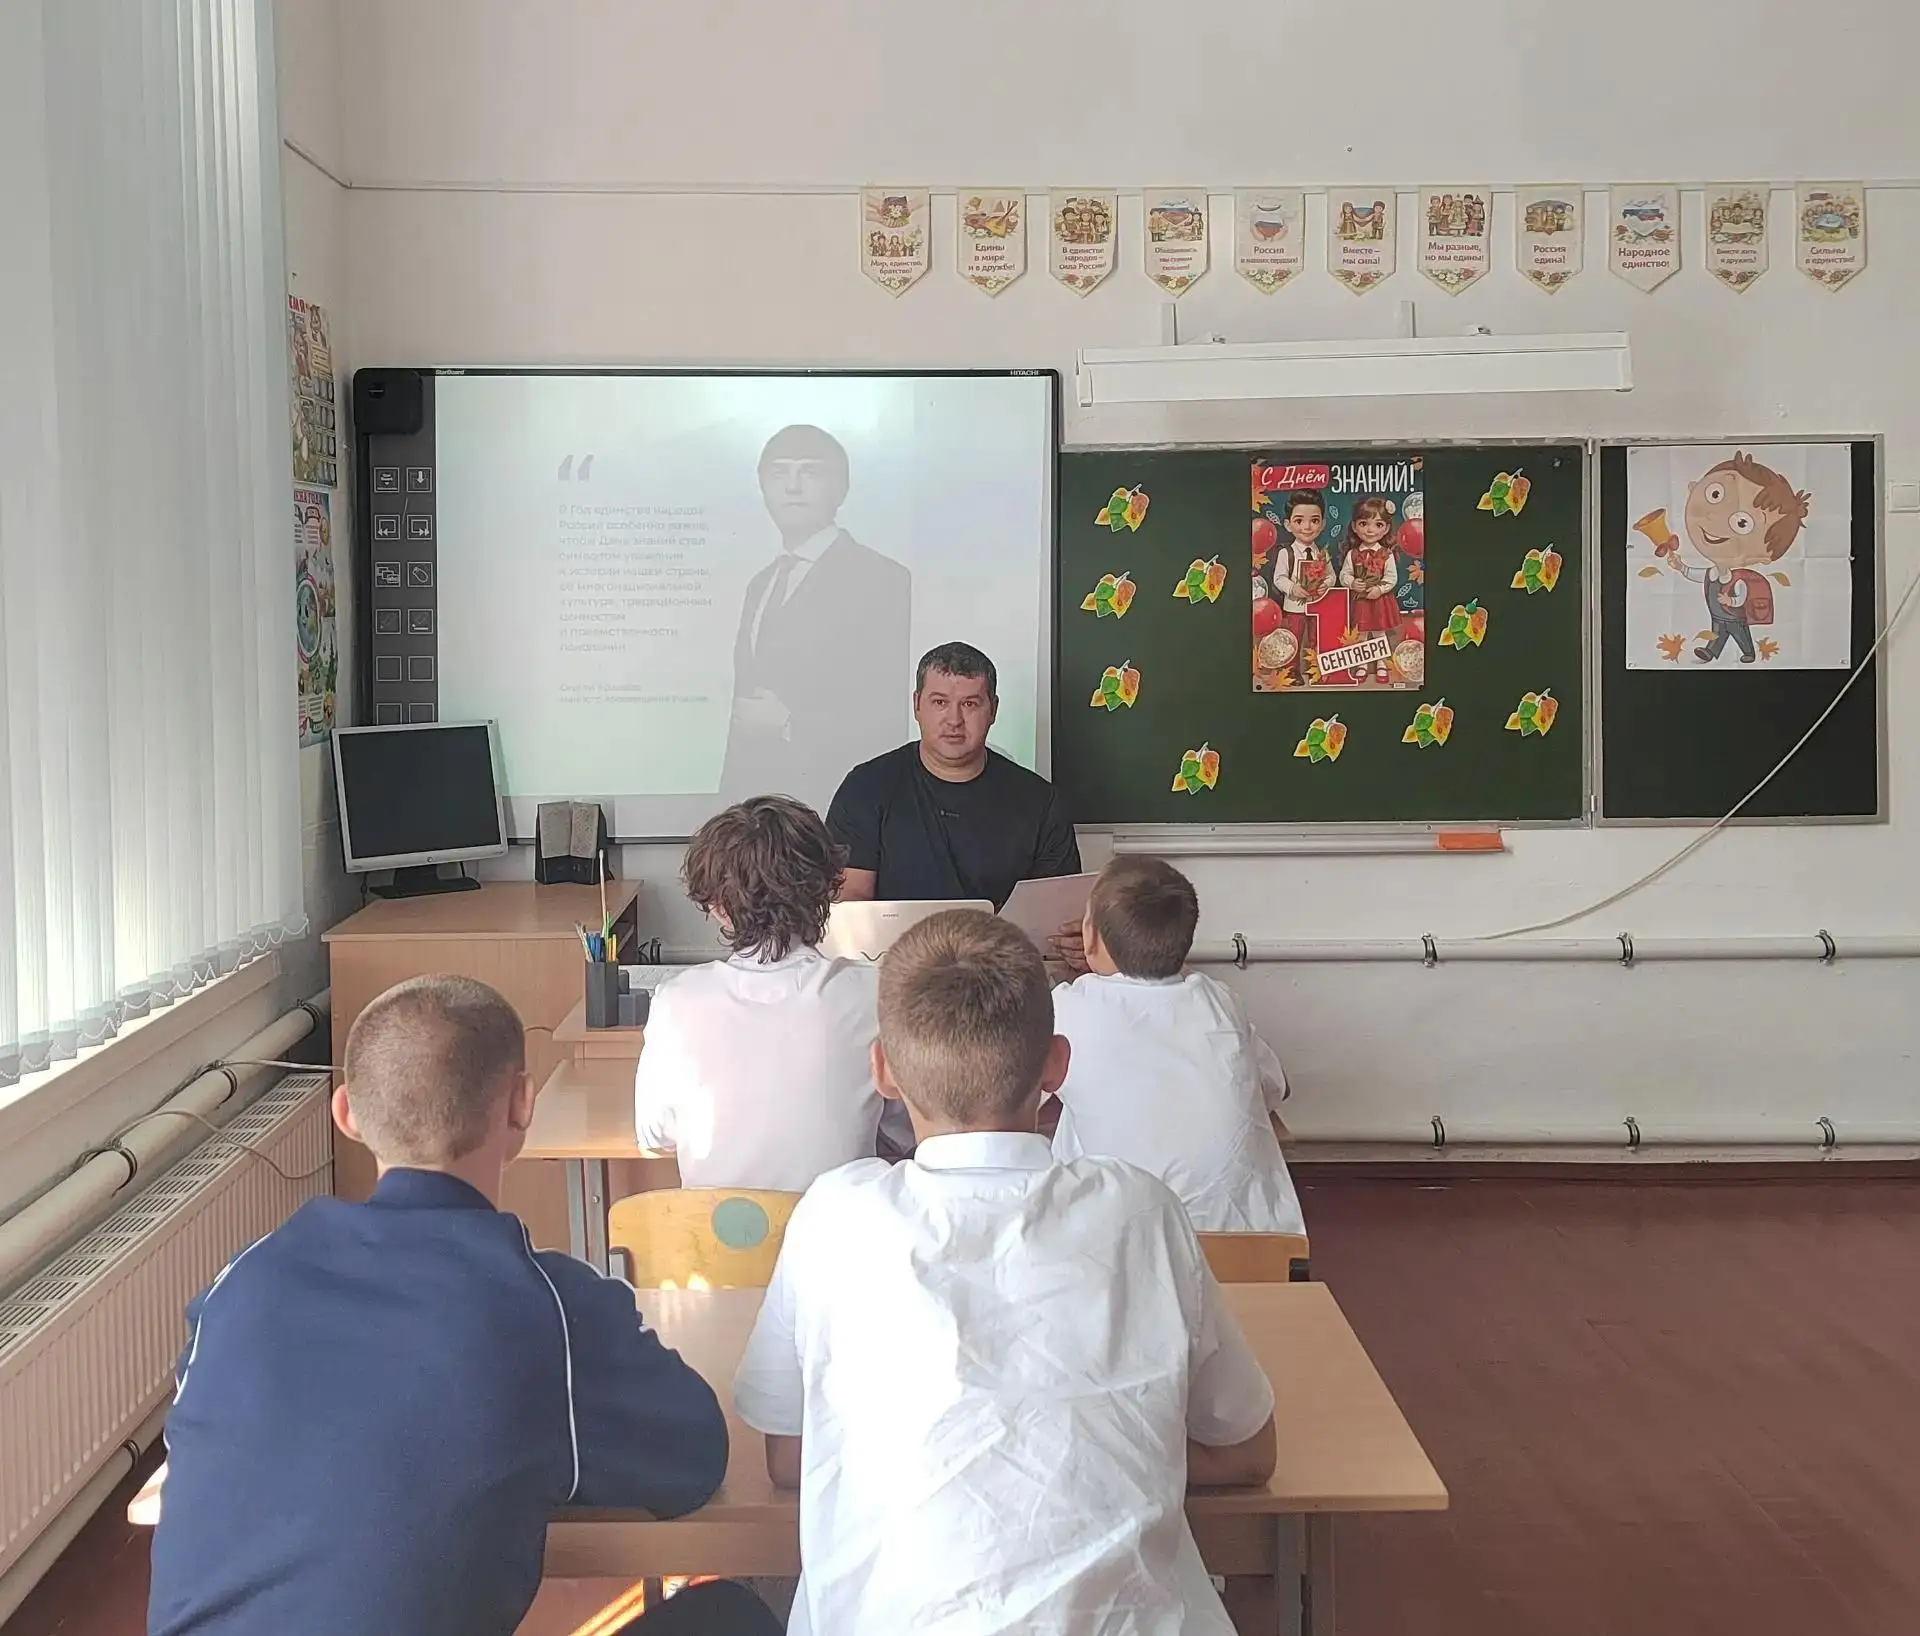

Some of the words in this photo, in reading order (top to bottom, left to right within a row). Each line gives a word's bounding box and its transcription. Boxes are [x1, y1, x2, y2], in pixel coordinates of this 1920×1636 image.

[975, 244, 1005, 253] Едины
[1428, 242, 1443, 251] Мы
[1446, 244, 1481, 252] разные,
[1534, 245, 1566, 253] Россия
[1811, 246, 1846, 255] Сильны
[1618, 248, 1670, 257] Народное
[982, 255, 1004, 263] мире
[1535, 255, 1565, 264] едина!
[982, 263, 1015, 272] дружбе!
[1622, 261, 1669, 269] единство!
[1261, 466, 1273, 485] С
[1277, 466, 1327, 488] Днём
[1331, 462, 1415, 493] ЗНАНИЙ!
[1305, 587, 1359, 686] 1
[1320, 639, 1388, 671] СЕНТЯБРЯ
